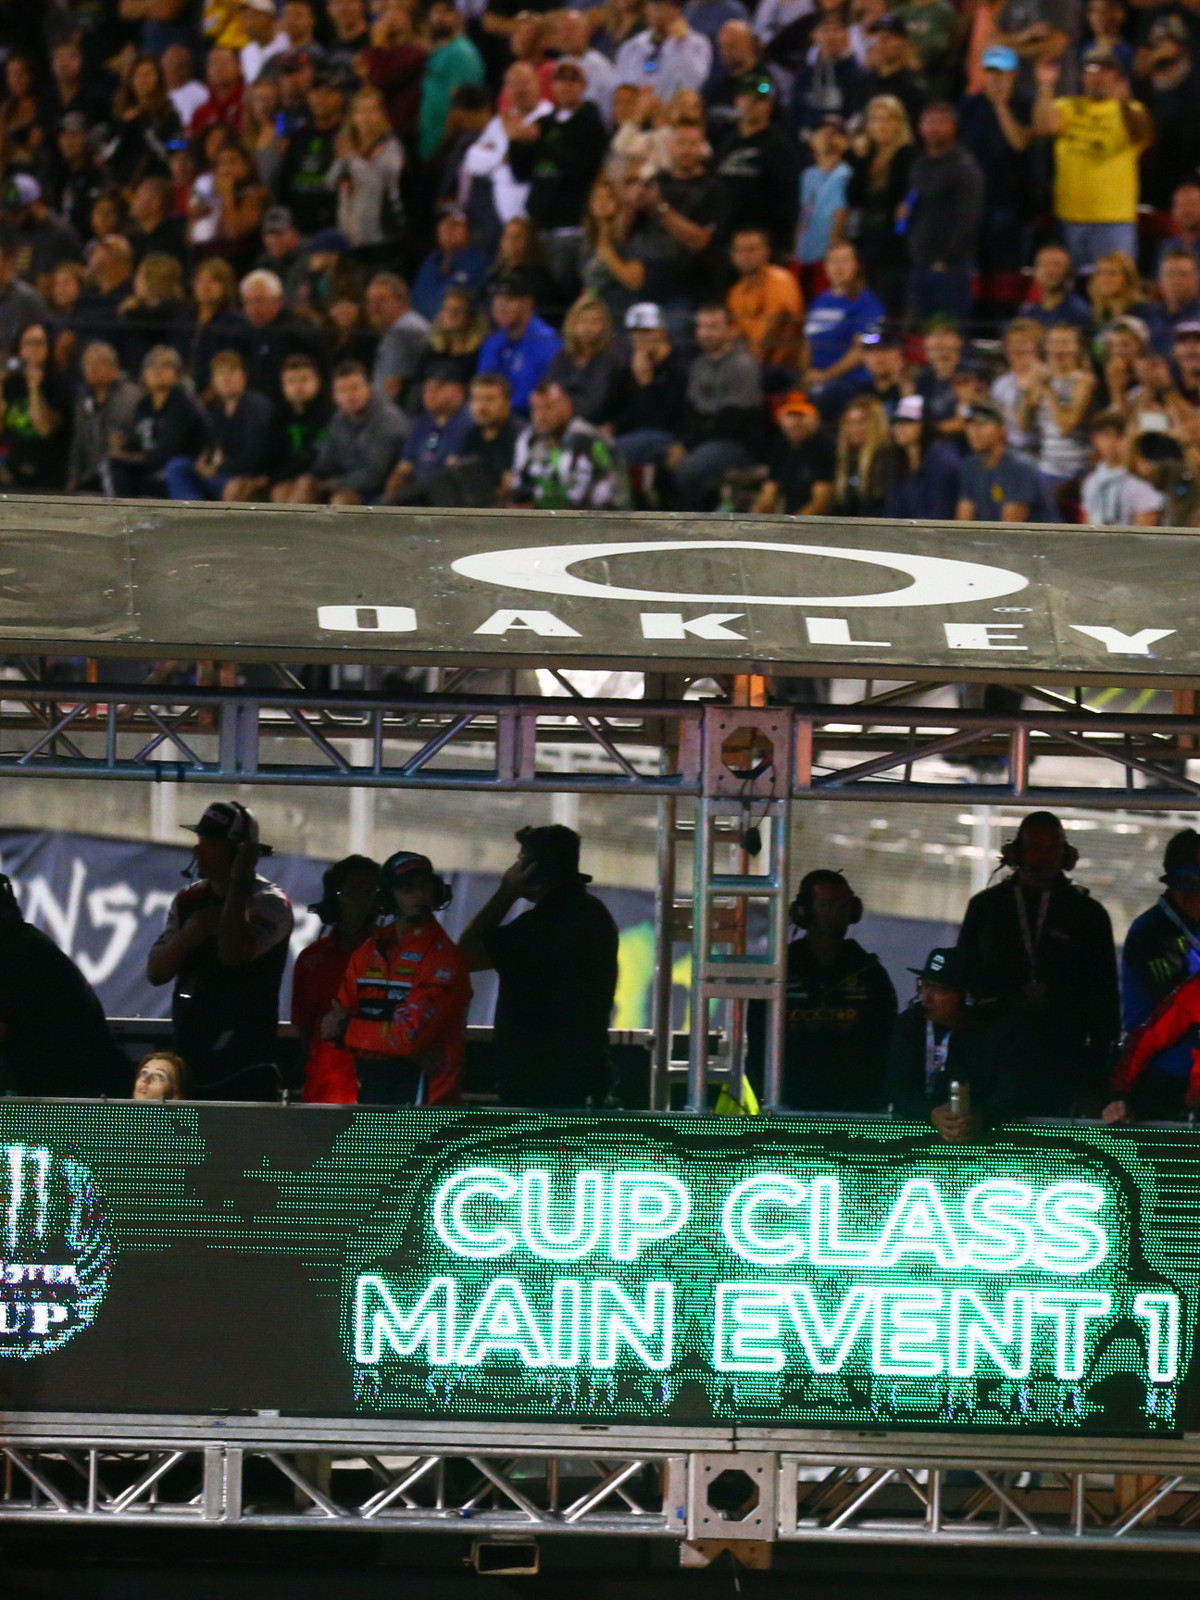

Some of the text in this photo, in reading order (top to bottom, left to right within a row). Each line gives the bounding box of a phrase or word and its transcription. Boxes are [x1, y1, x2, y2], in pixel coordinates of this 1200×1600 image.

[317, 605, 1177, 655] OAKLEY
[432, 1165, 1110, 1275] CUP CLASS
[354, 1274, 1180, 1383] MAIN EVENT 1
